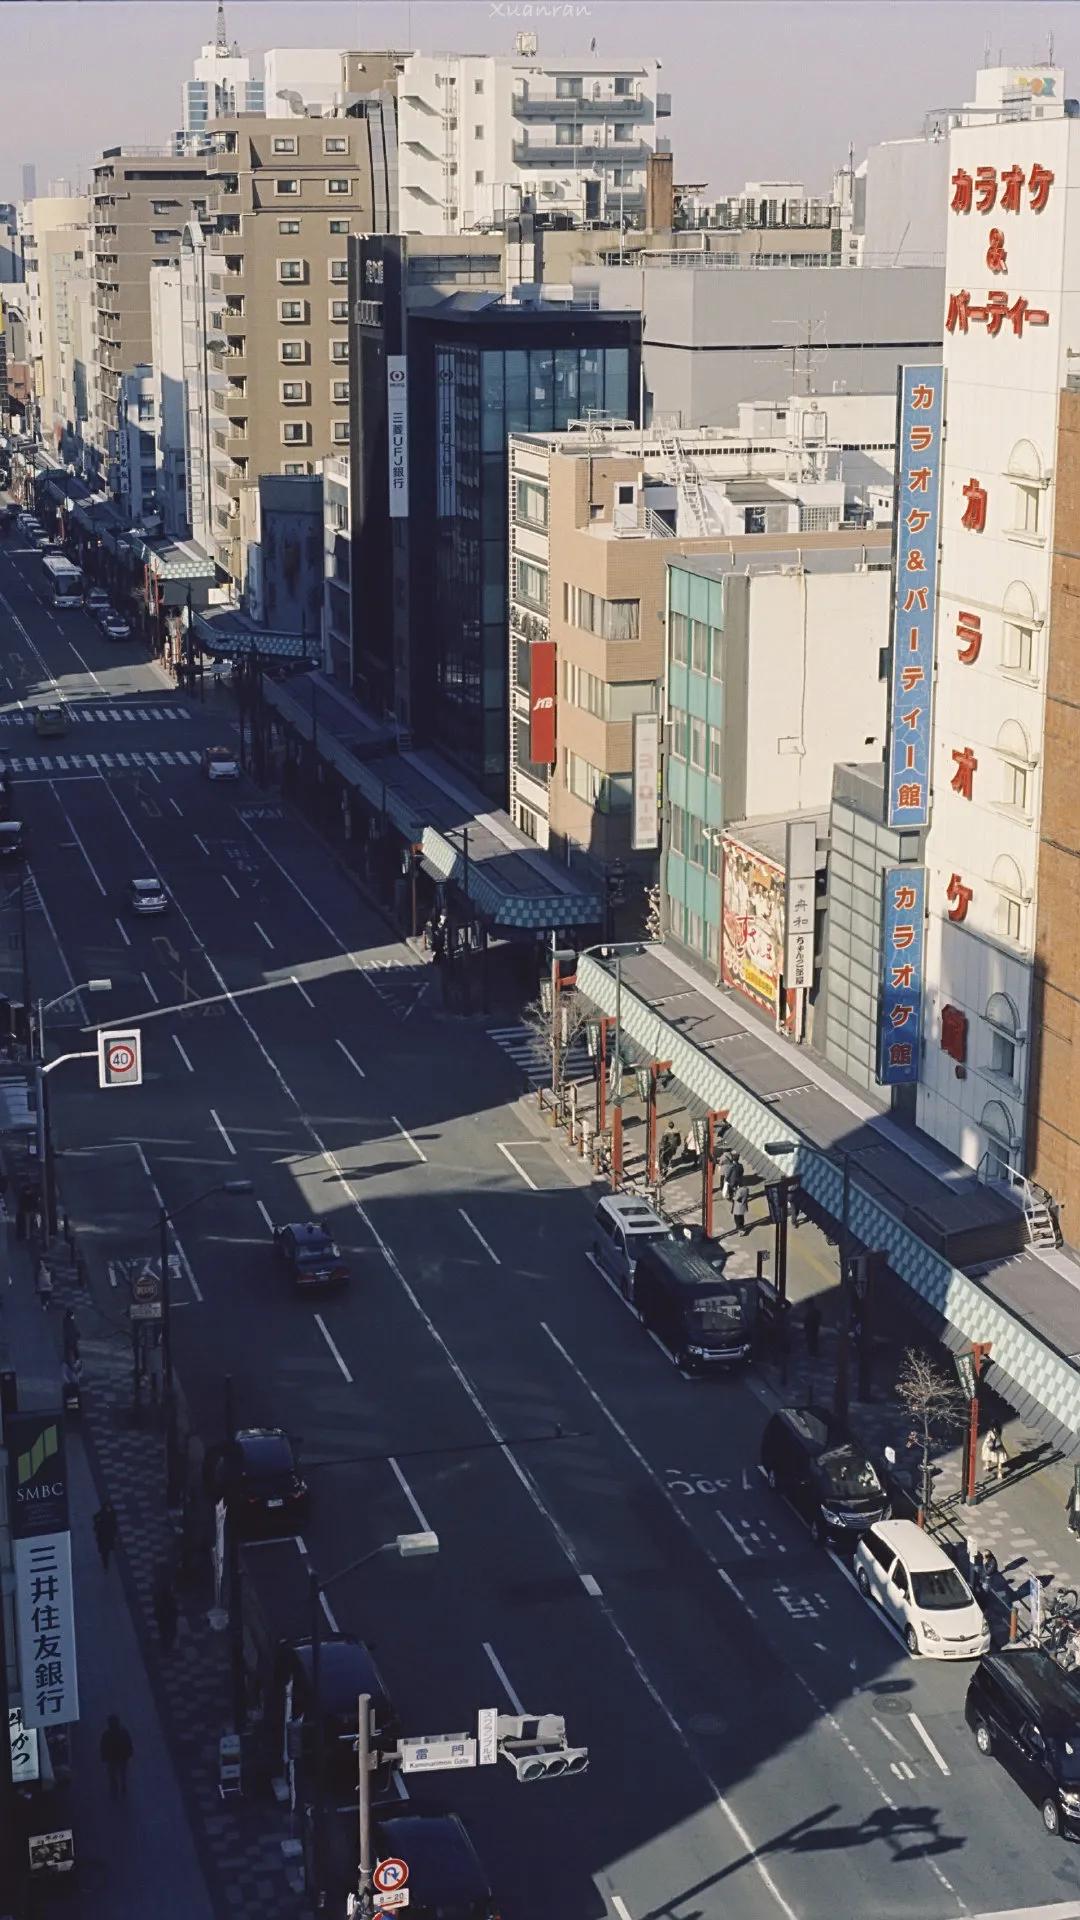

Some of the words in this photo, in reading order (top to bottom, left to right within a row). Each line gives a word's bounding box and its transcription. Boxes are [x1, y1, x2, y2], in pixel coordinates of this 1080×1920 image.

[950, 163, 1055, 214] カラオケ
[986, 227, 1008, 273] &
[946, 289, 1050, 337] パーティー
[393, 411, 404, 489] 三菱UFJ銀行
[897, 384, 935, 808] カラオケ&パーティー館
[533, 696, 554, 711] JTB
[889, 886, 917, 1067] カラオケ館
[112, 1052, 129, 1066] 40
[16, 1482, 64, 1502] SMBC
[29, 1545, 64, 1716] 三井住友銀行
[415, 1744, 464, 1760] 雷門
